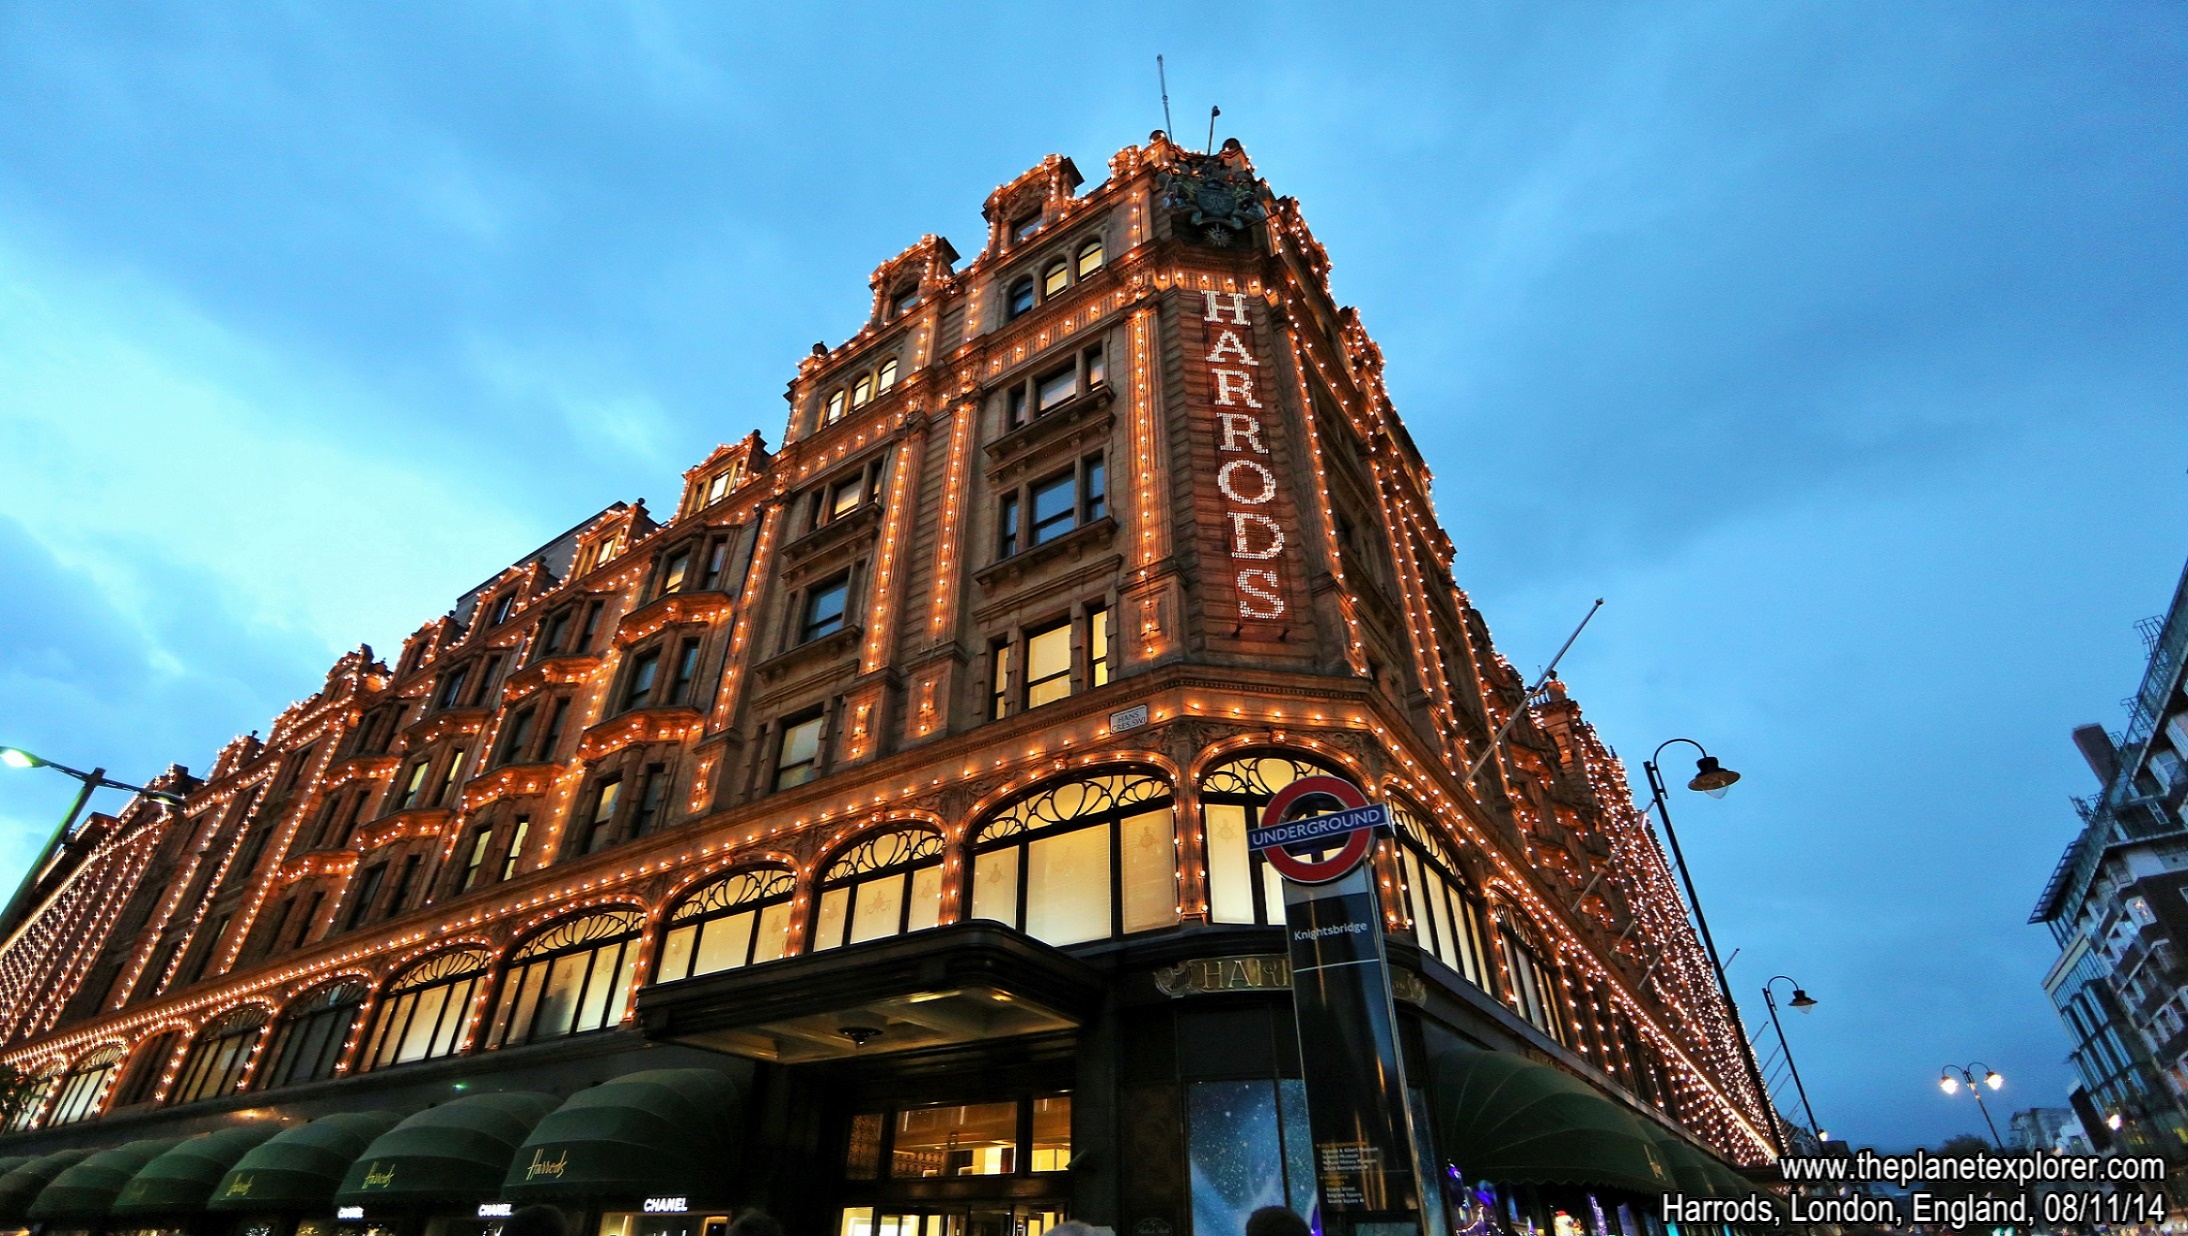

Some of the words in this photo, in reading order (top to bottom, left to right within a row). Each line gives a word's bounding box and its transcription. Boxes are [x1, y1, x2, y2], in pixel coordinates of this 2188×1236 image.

[1200, 289, 1286, 619] HARRODS
[1252, 809, 1381, 846] UNDERGROUND
[1294, 922, 1368, 941] Knightsbridge
[526, 1148, 568, 1180] Harrods
[478, 1203, 513, 1217] CHANEL
[643, 1197, 688, 1213] CHANEL
